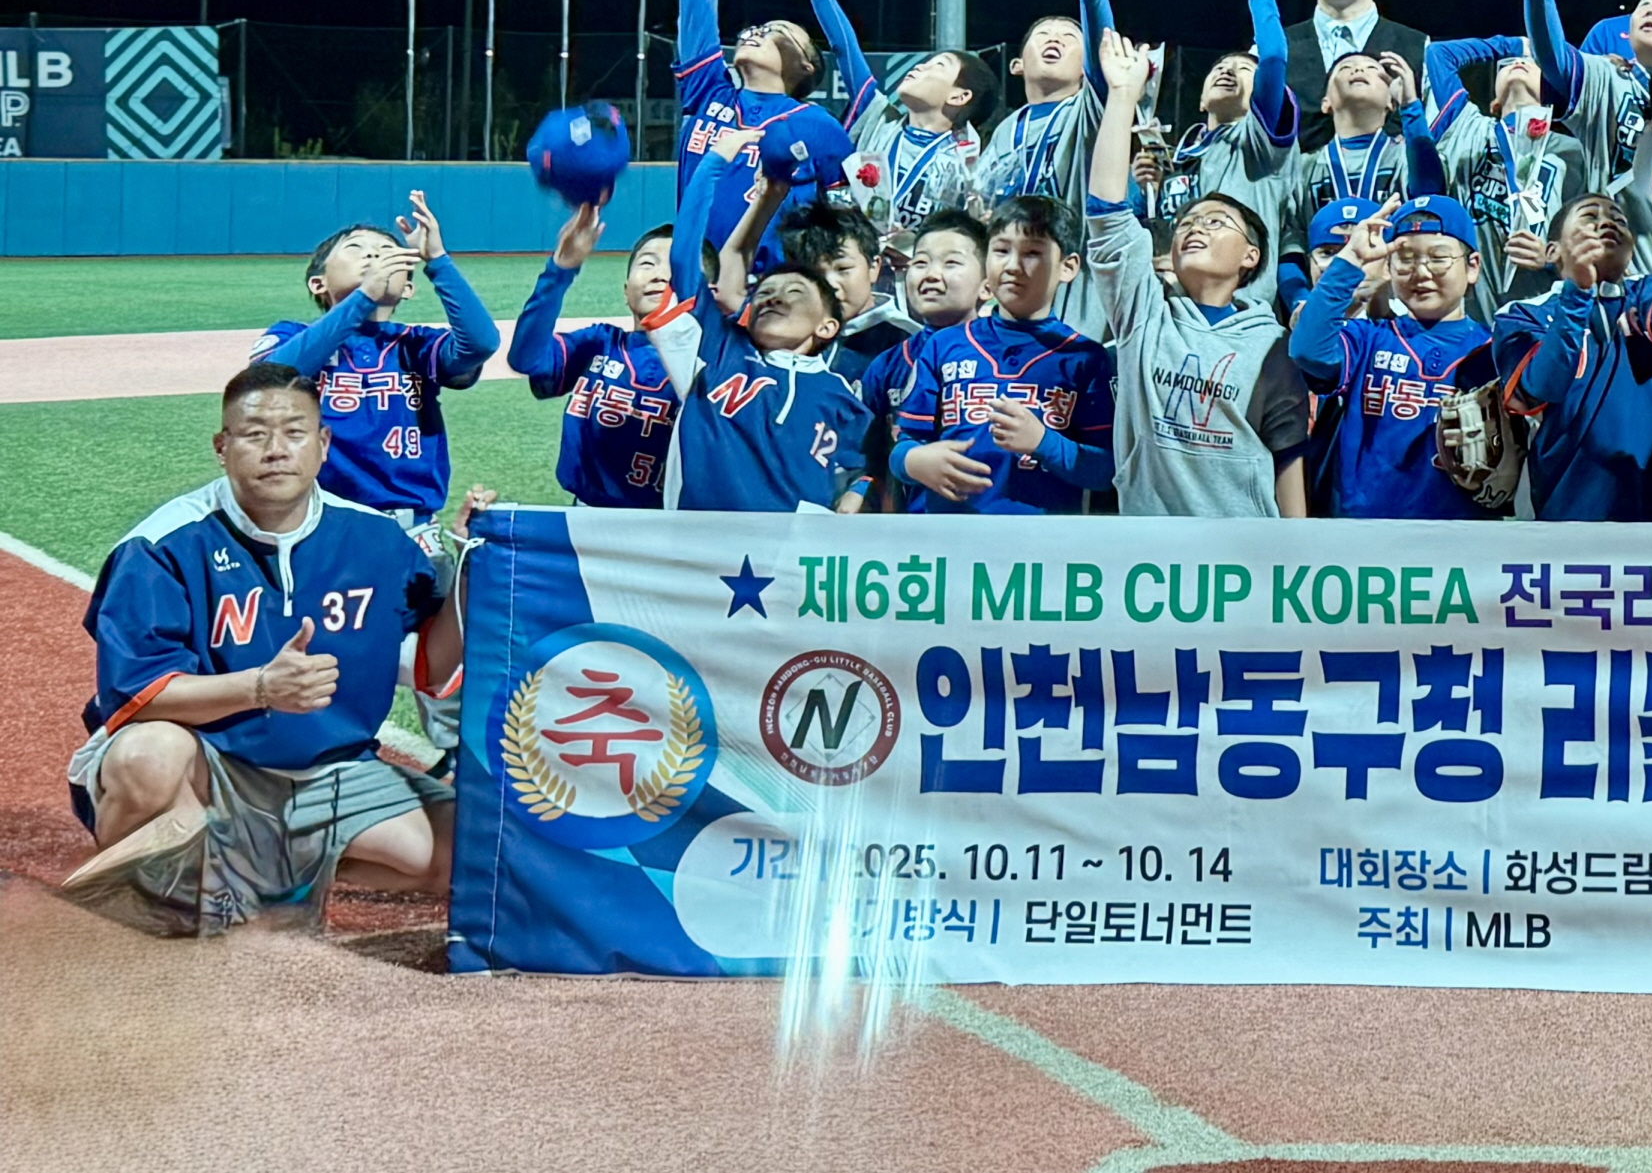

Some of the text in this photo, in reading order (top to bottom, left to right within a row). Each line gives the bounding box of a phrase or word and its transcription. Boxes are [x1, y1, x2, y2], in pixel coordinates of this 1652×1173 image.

[0, 51, 73, 88] LB
[707, 372, 777, 418] N
[382, 426, 421, 459] 49
[810, 421, 838, 468] 12
[321, 587, 374, 632] 37
[797, 554, 945, 625] 제6회
[971, 563, 1103, 623] MLB
[1124, 563, 1252, 624] CUP
[1271, 565, 1480, 625] KOREA
[210, 586, 264, 649] N
[829, 656, 862, 671] LITTLE
[541, 668, 664, 796] 축
[790, 680, 865, 749] N
[916, 643, 1504, 803] 인천남동구청
[1320, 847, 1468, 892] 대회장소
[1025, 900, 1252, 945] 단일토너먼트
[1357, 905, 1430, 951] 주최
[1466, 912, 1552, 950] MLB
